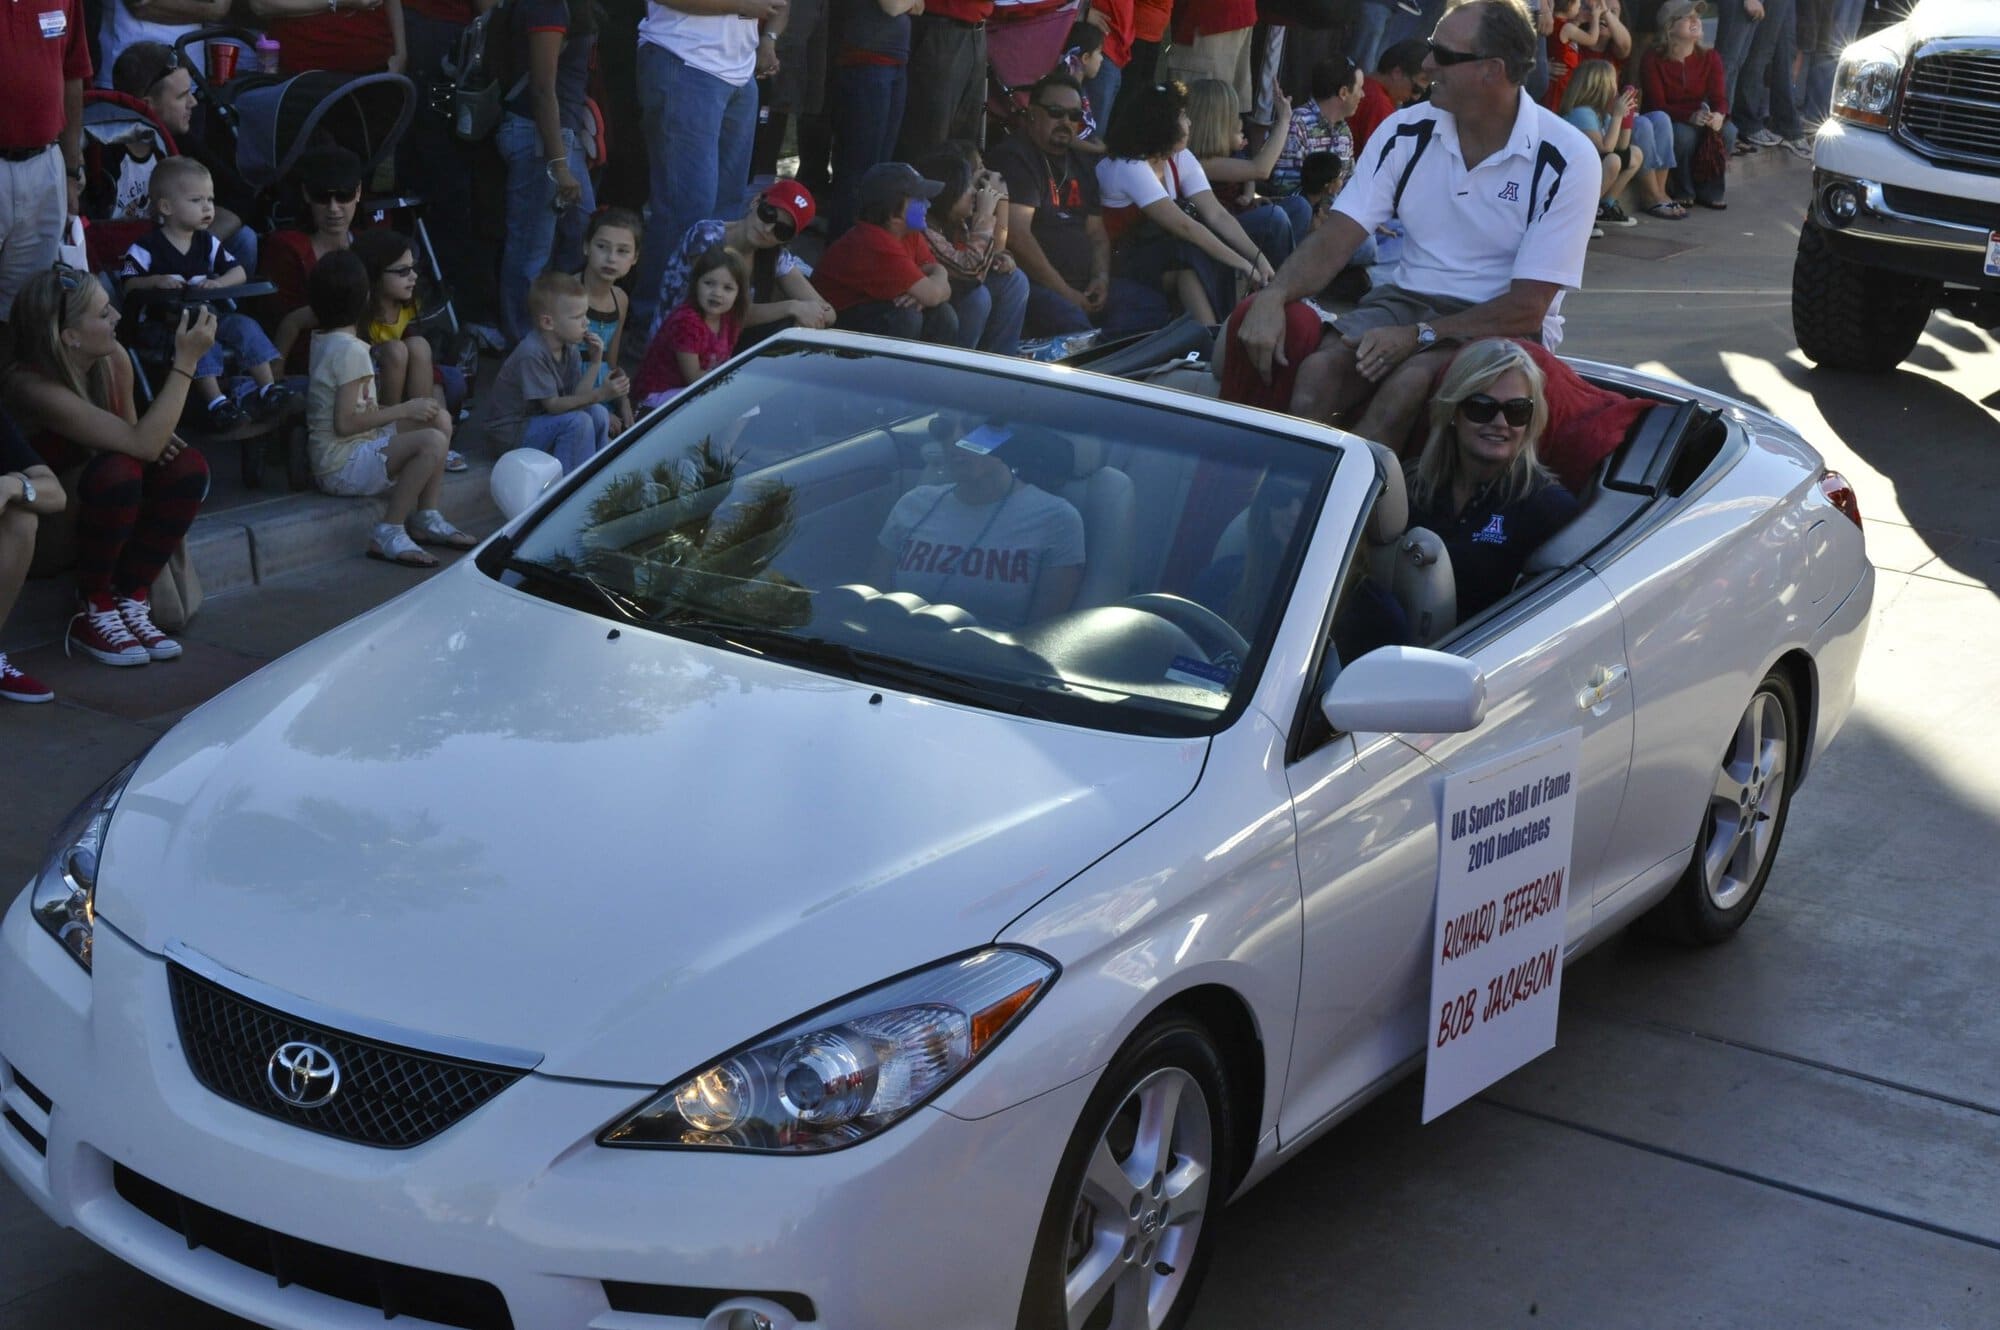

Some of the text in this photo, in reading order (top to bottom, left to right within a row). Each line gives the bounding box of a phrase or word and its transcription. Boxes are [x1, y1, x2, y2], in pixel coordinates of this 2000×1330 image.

[1498, 181, 1519, 201] A
[899, 539, 1030, 584] ARIZONA
[1451, 771, 1571, 841] UA Sports Hall of Fame
[1468, 816, 1551, 873] 2010 Inductees
[1442, 866, 1565, 965] RICHARD JEFFERSON
[1437, 944, 1558, 1048] BOB JACKSON
